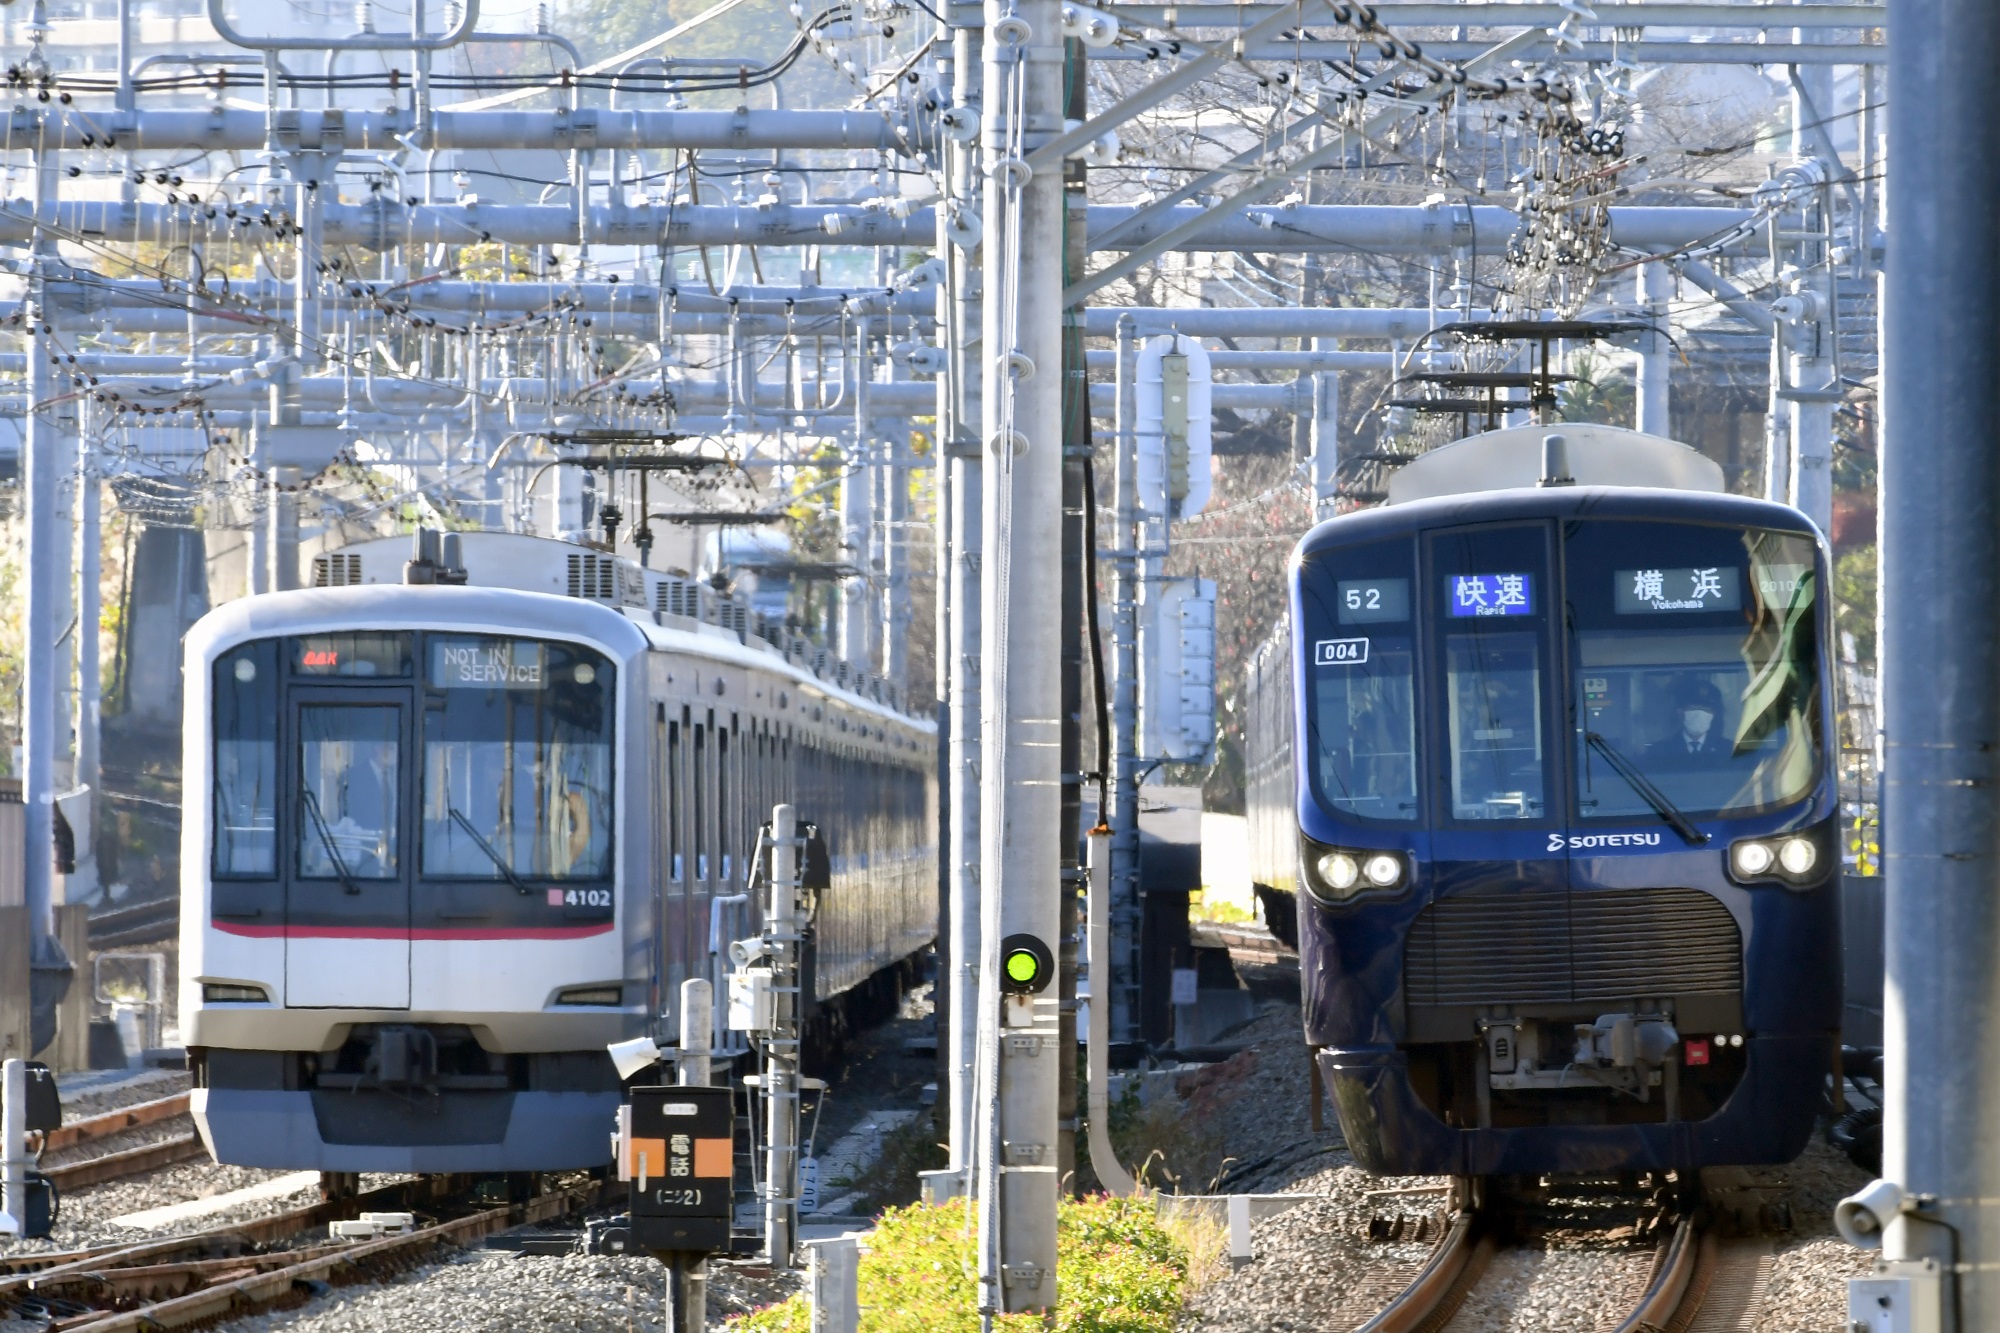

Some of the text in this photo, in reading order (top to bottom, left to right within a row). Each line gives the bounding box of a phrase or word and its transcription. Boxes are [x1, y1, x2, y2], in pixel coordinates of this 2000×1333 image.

[1456, 573, 1527, 606] 快速
[1633, 567, 1723, 601] 横浜
[1346, 588, 1381, 610] 52
[1651, 599, 1704, 610] Yokohama
[1475, 604, 1506, 616] Rapid
[444, 647, 508, 665] NOT IN
[1324, 643, 1358, 660] 004
[459, 665, 541, 683] SERVICE
[1568, 833, 1661, 849] SOTETSU
[565, 889, 611, 907] 4102
[669, 1134, 691, 1177] 電話
